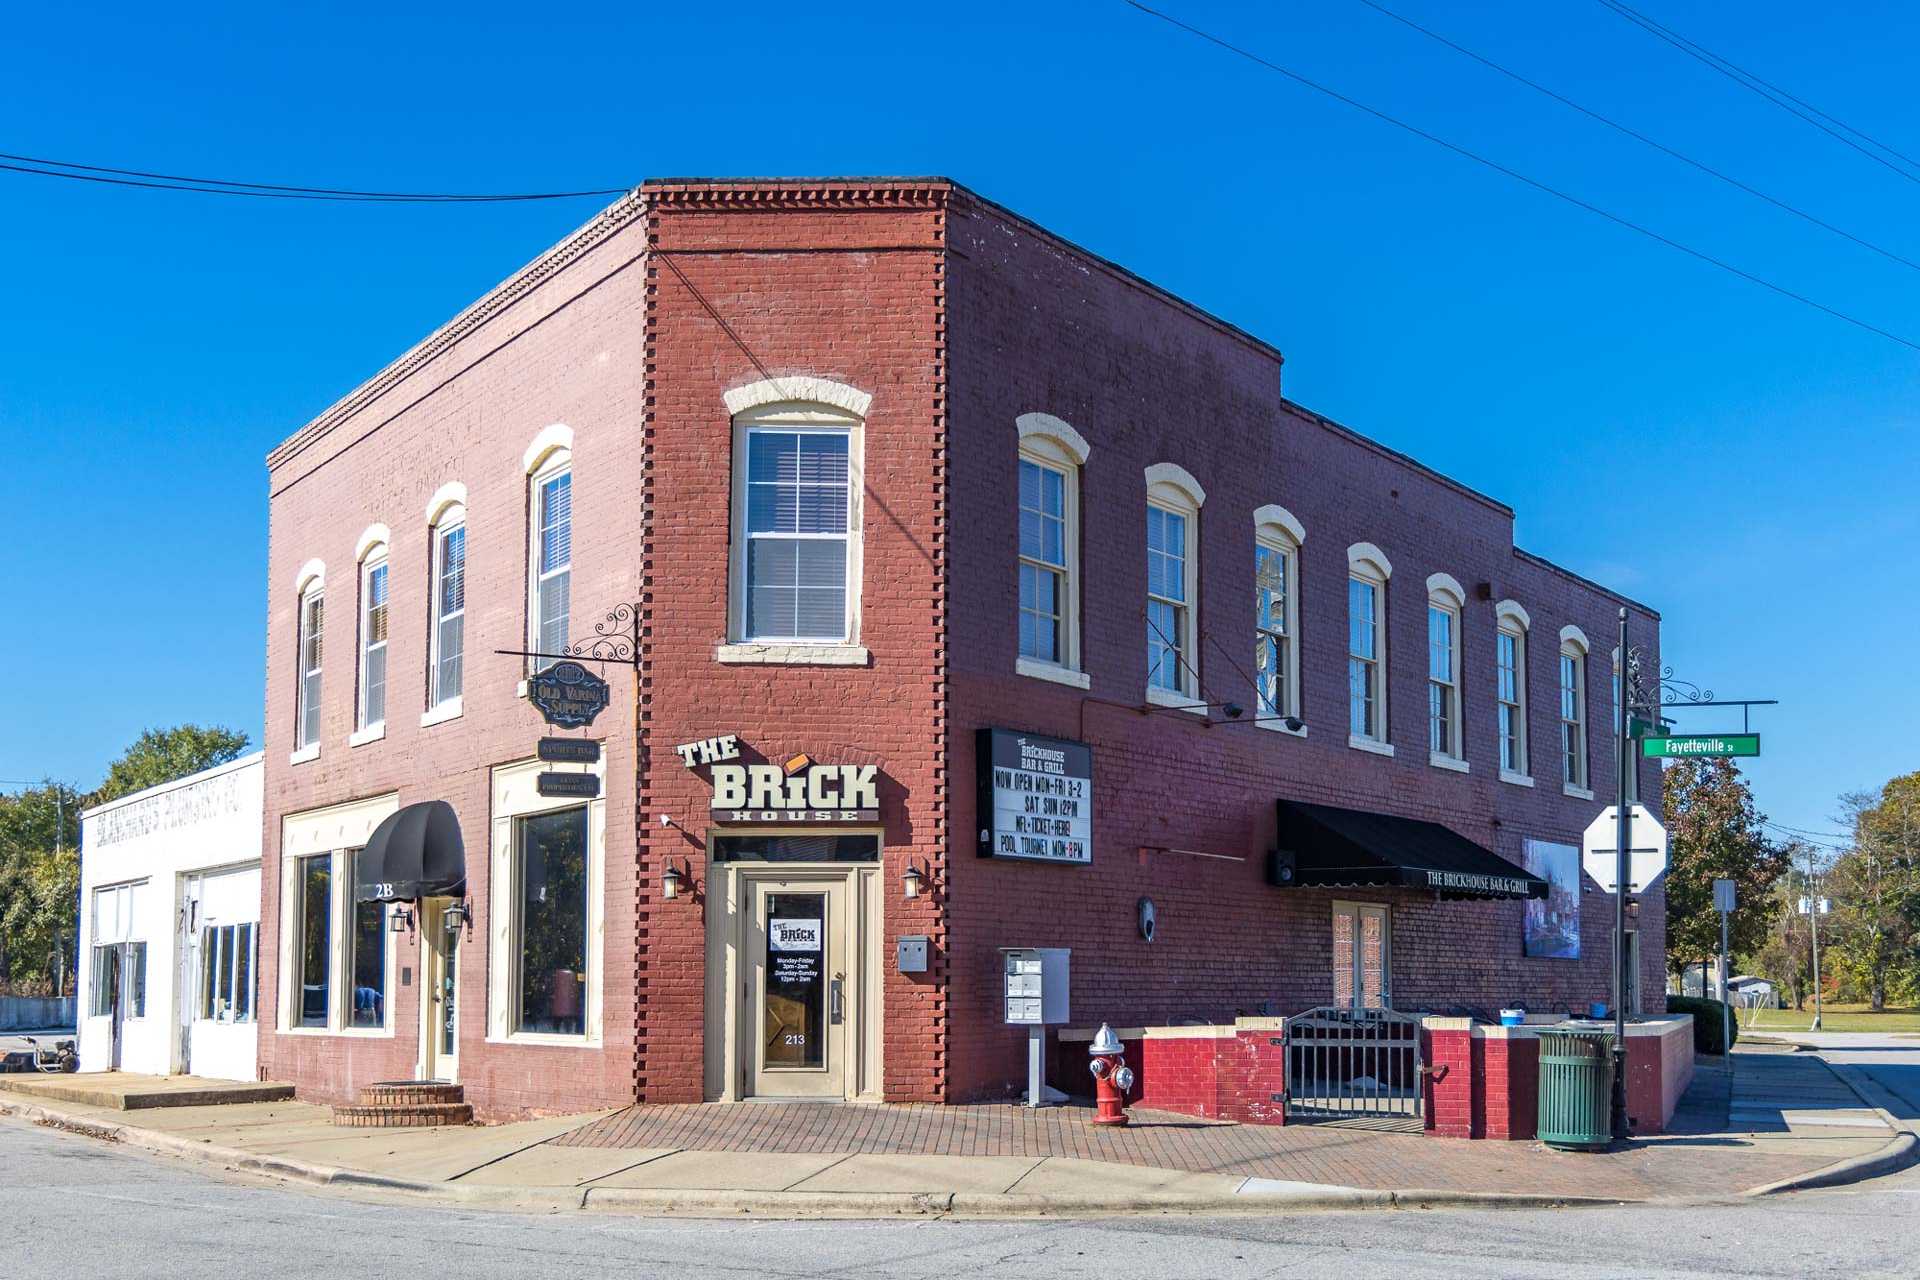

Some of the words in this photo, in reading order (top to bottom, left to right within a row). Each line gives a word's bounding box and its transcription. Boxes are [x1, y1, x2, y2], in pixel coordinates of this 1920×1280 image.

[677, 734, 740, 768] THE
[1665, 739, 1724, 754] Fayetteville
[1021, 758, 1036, 770] BAR
[1038, 760, 1043, 771] &
[1044, 761, 1065, 775] GRILL
[995, 769, 1012, 789] NOW
[1014, 772, 1032, 792] OPEN
[1068, 780, 1082, 798] 3-2
[1024, 795, 1040, 813] SAT
[1043, 797, 1058, 816] SUN
[731, 811, 859, 821] HOUSE
[1000, 834, 1016, 853] POOL
[376, 883, 394, 898] 2B
[1426, 871, 1442, 885] THE
[1443, 872, 1489, 890] BRICKHOUSE
[1510, 880, 1530, 894] GRILL
[785, 1034, 806, 1045] 213
